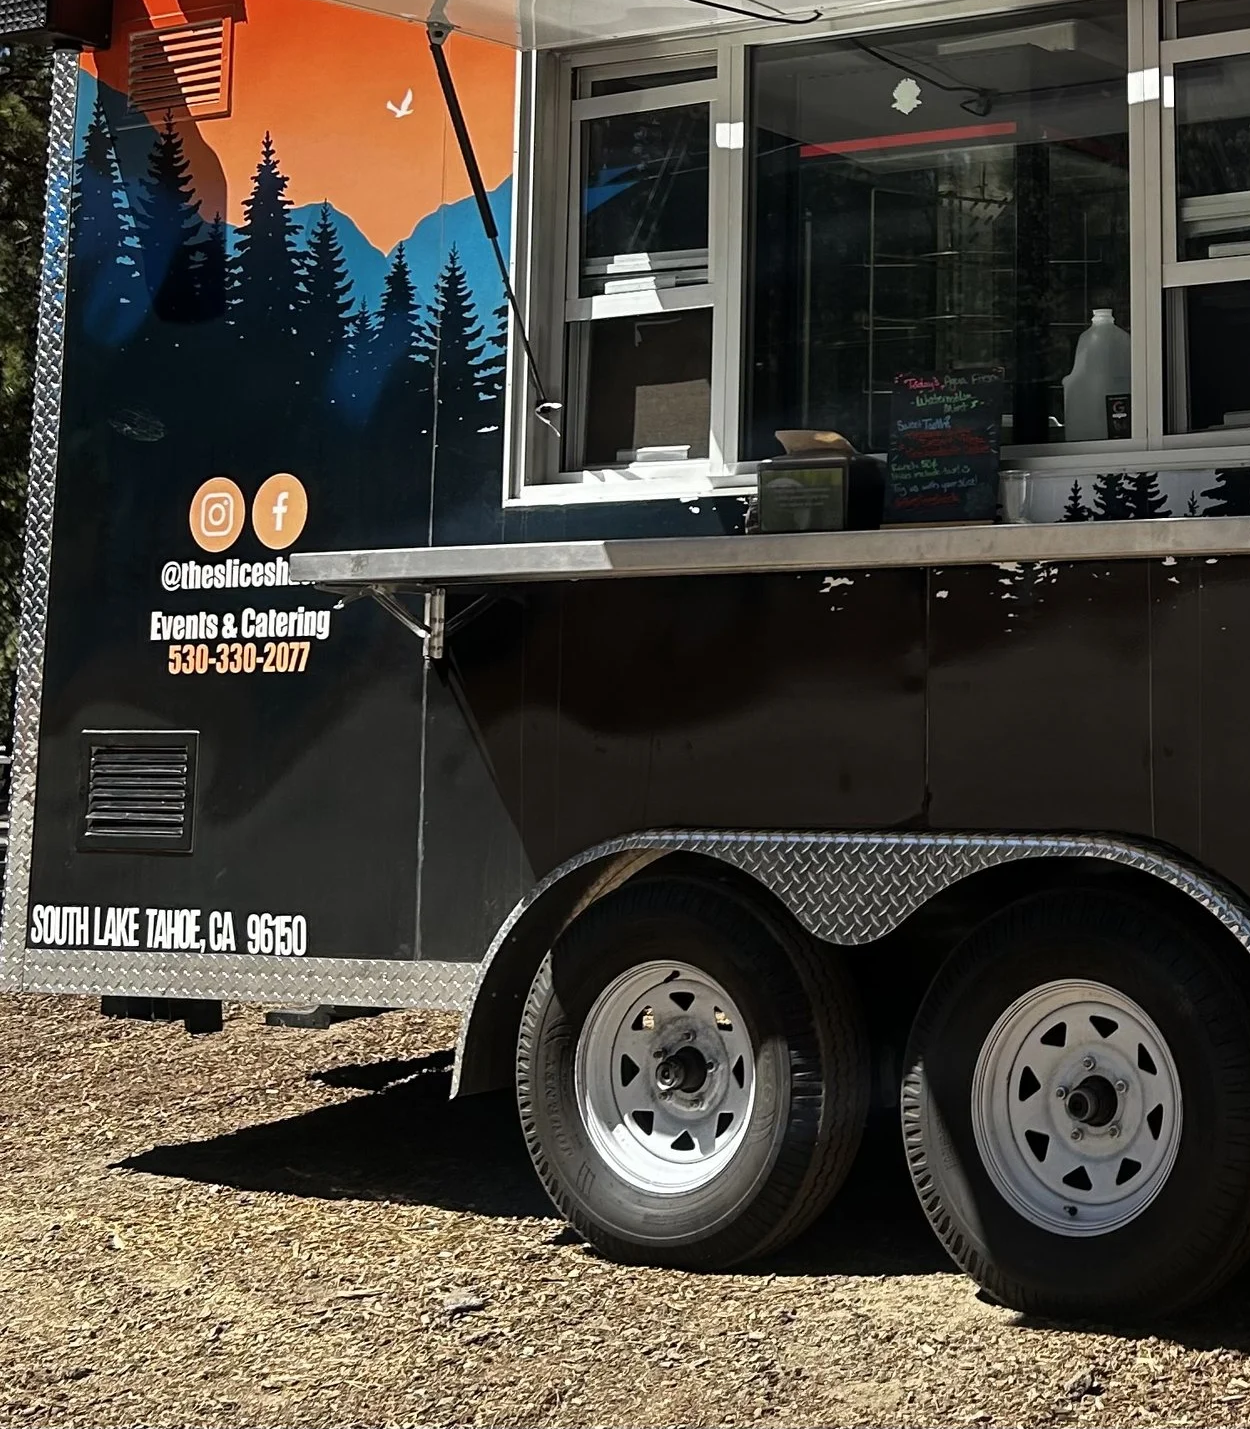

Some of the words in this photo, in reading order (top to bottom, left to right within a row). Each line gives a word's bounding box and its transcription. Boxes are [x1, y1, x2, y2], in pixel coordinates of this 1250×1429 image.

[161, 553, 316, 592] @theslicesh
[150, 611, 219, 641] Events
[222, 612, 239, 640] &
[241, 606, 331, 640] Catering
[168, 641, 311, 675] 530-330-2077
[31, 904, 90, 947] SOUTH
[93, 906, 141, 947] LAKE
[145, 908, 207, 952] TAHOE,
[208, 910, 237, 952] CA
[247, 913, 307, 956] 96150
